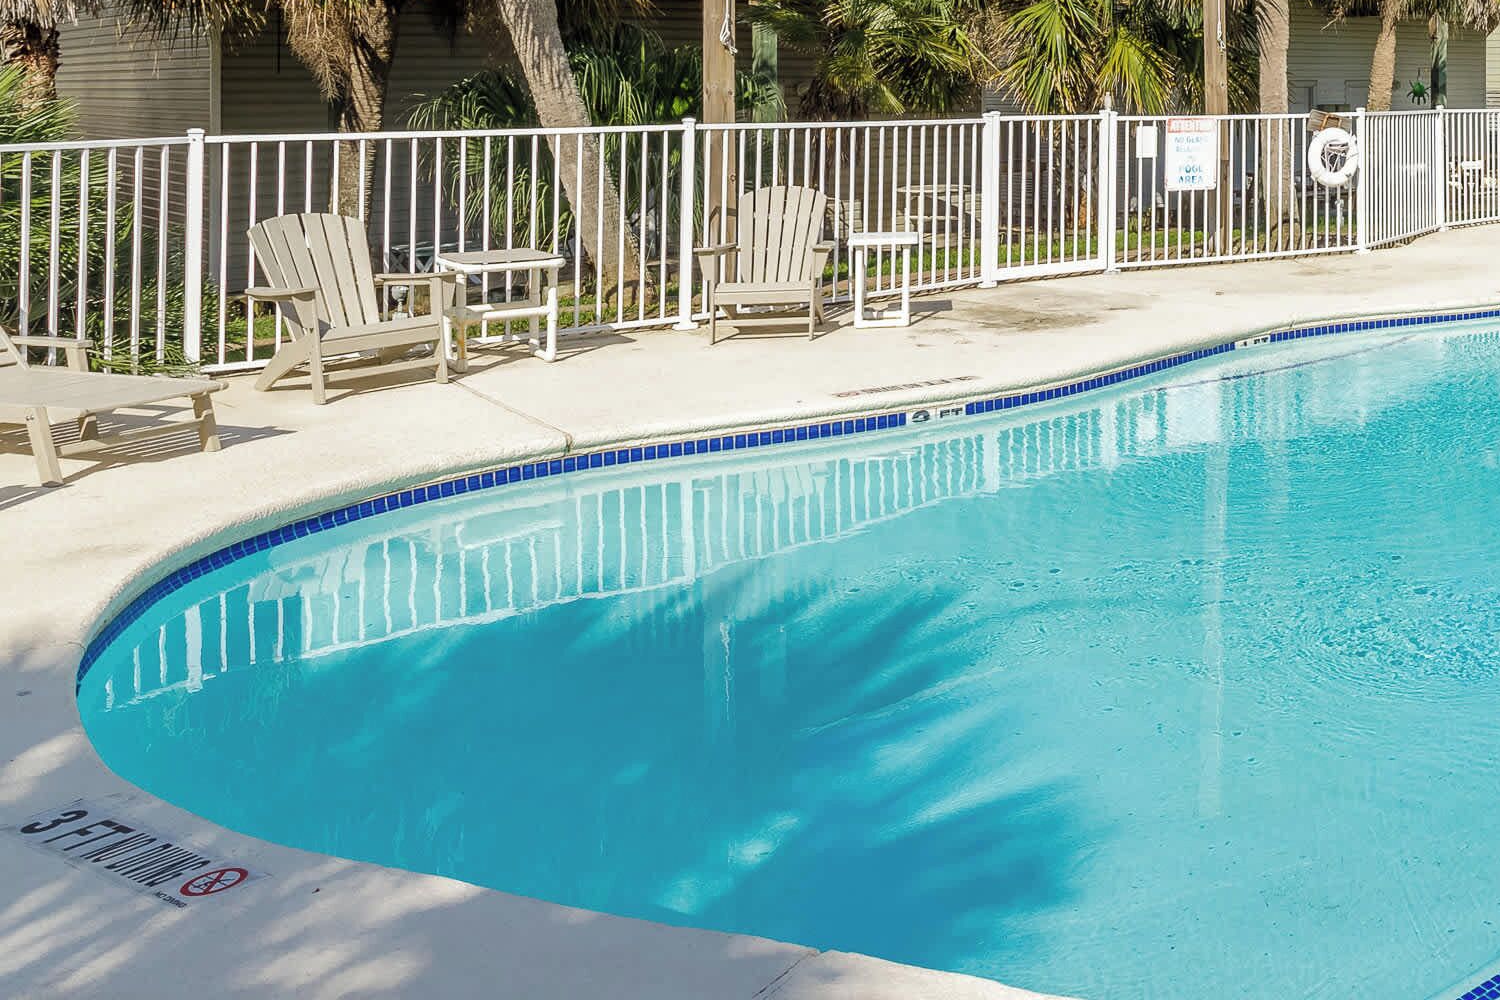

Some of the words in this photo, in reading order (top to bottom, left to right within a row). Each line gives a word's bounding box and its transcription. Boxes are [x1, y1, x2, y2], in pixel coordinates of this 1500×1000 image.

[20, 810, 88, 834] 3
[42, 819, 136, 851] FT
[80, 832, 158, 863] NO
[104, 843, 211, 888] DIVING
